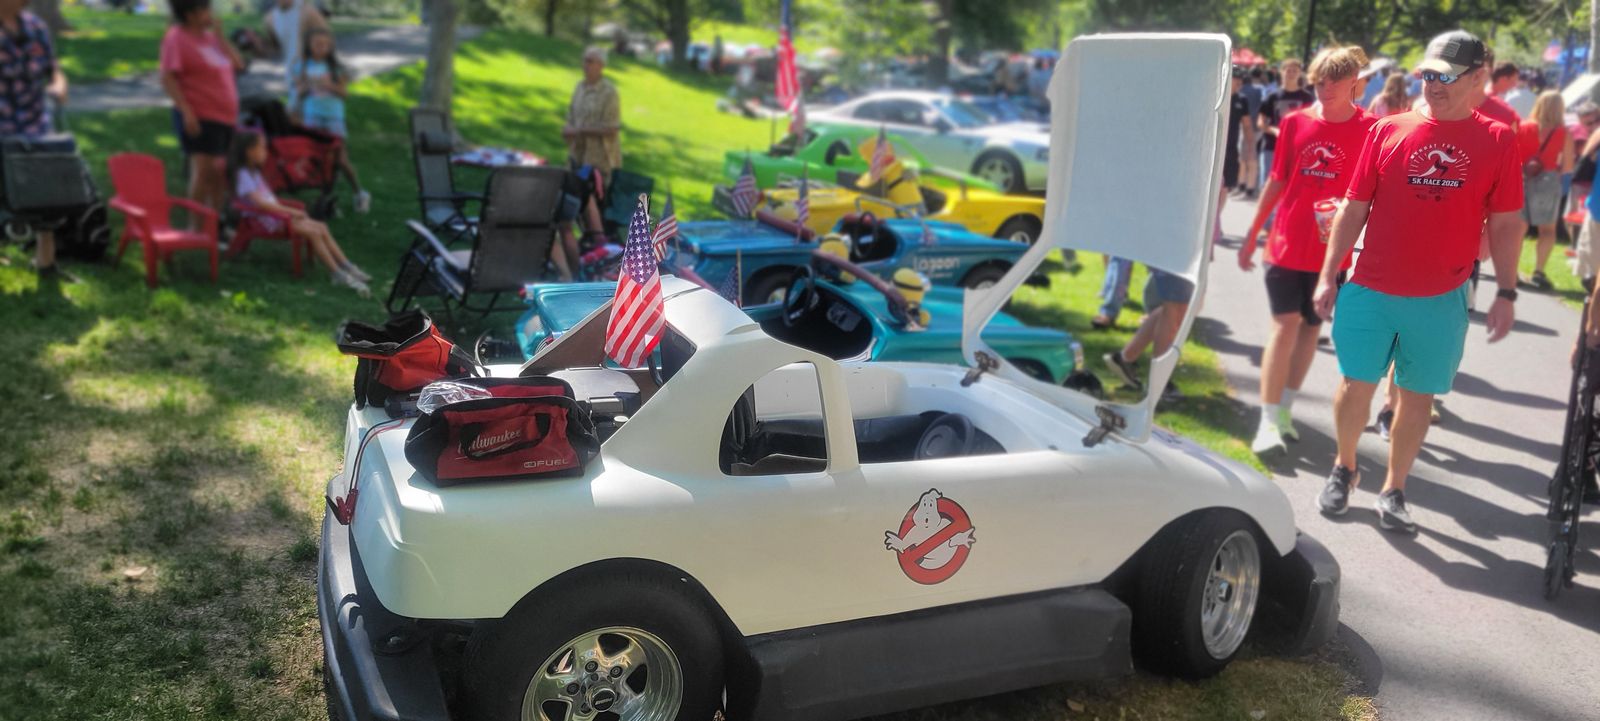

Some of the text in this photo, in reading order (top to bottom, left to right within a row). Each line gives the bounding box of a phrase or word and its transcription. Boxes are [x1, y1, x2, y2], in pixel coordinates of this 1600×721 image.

[1423, 178, 1441, 186] RACE
[912, 256, 960, 276] Lagoon
[457, 429, 521, 454] ilwaukee
[537, 458, 568, 467] FUEL
